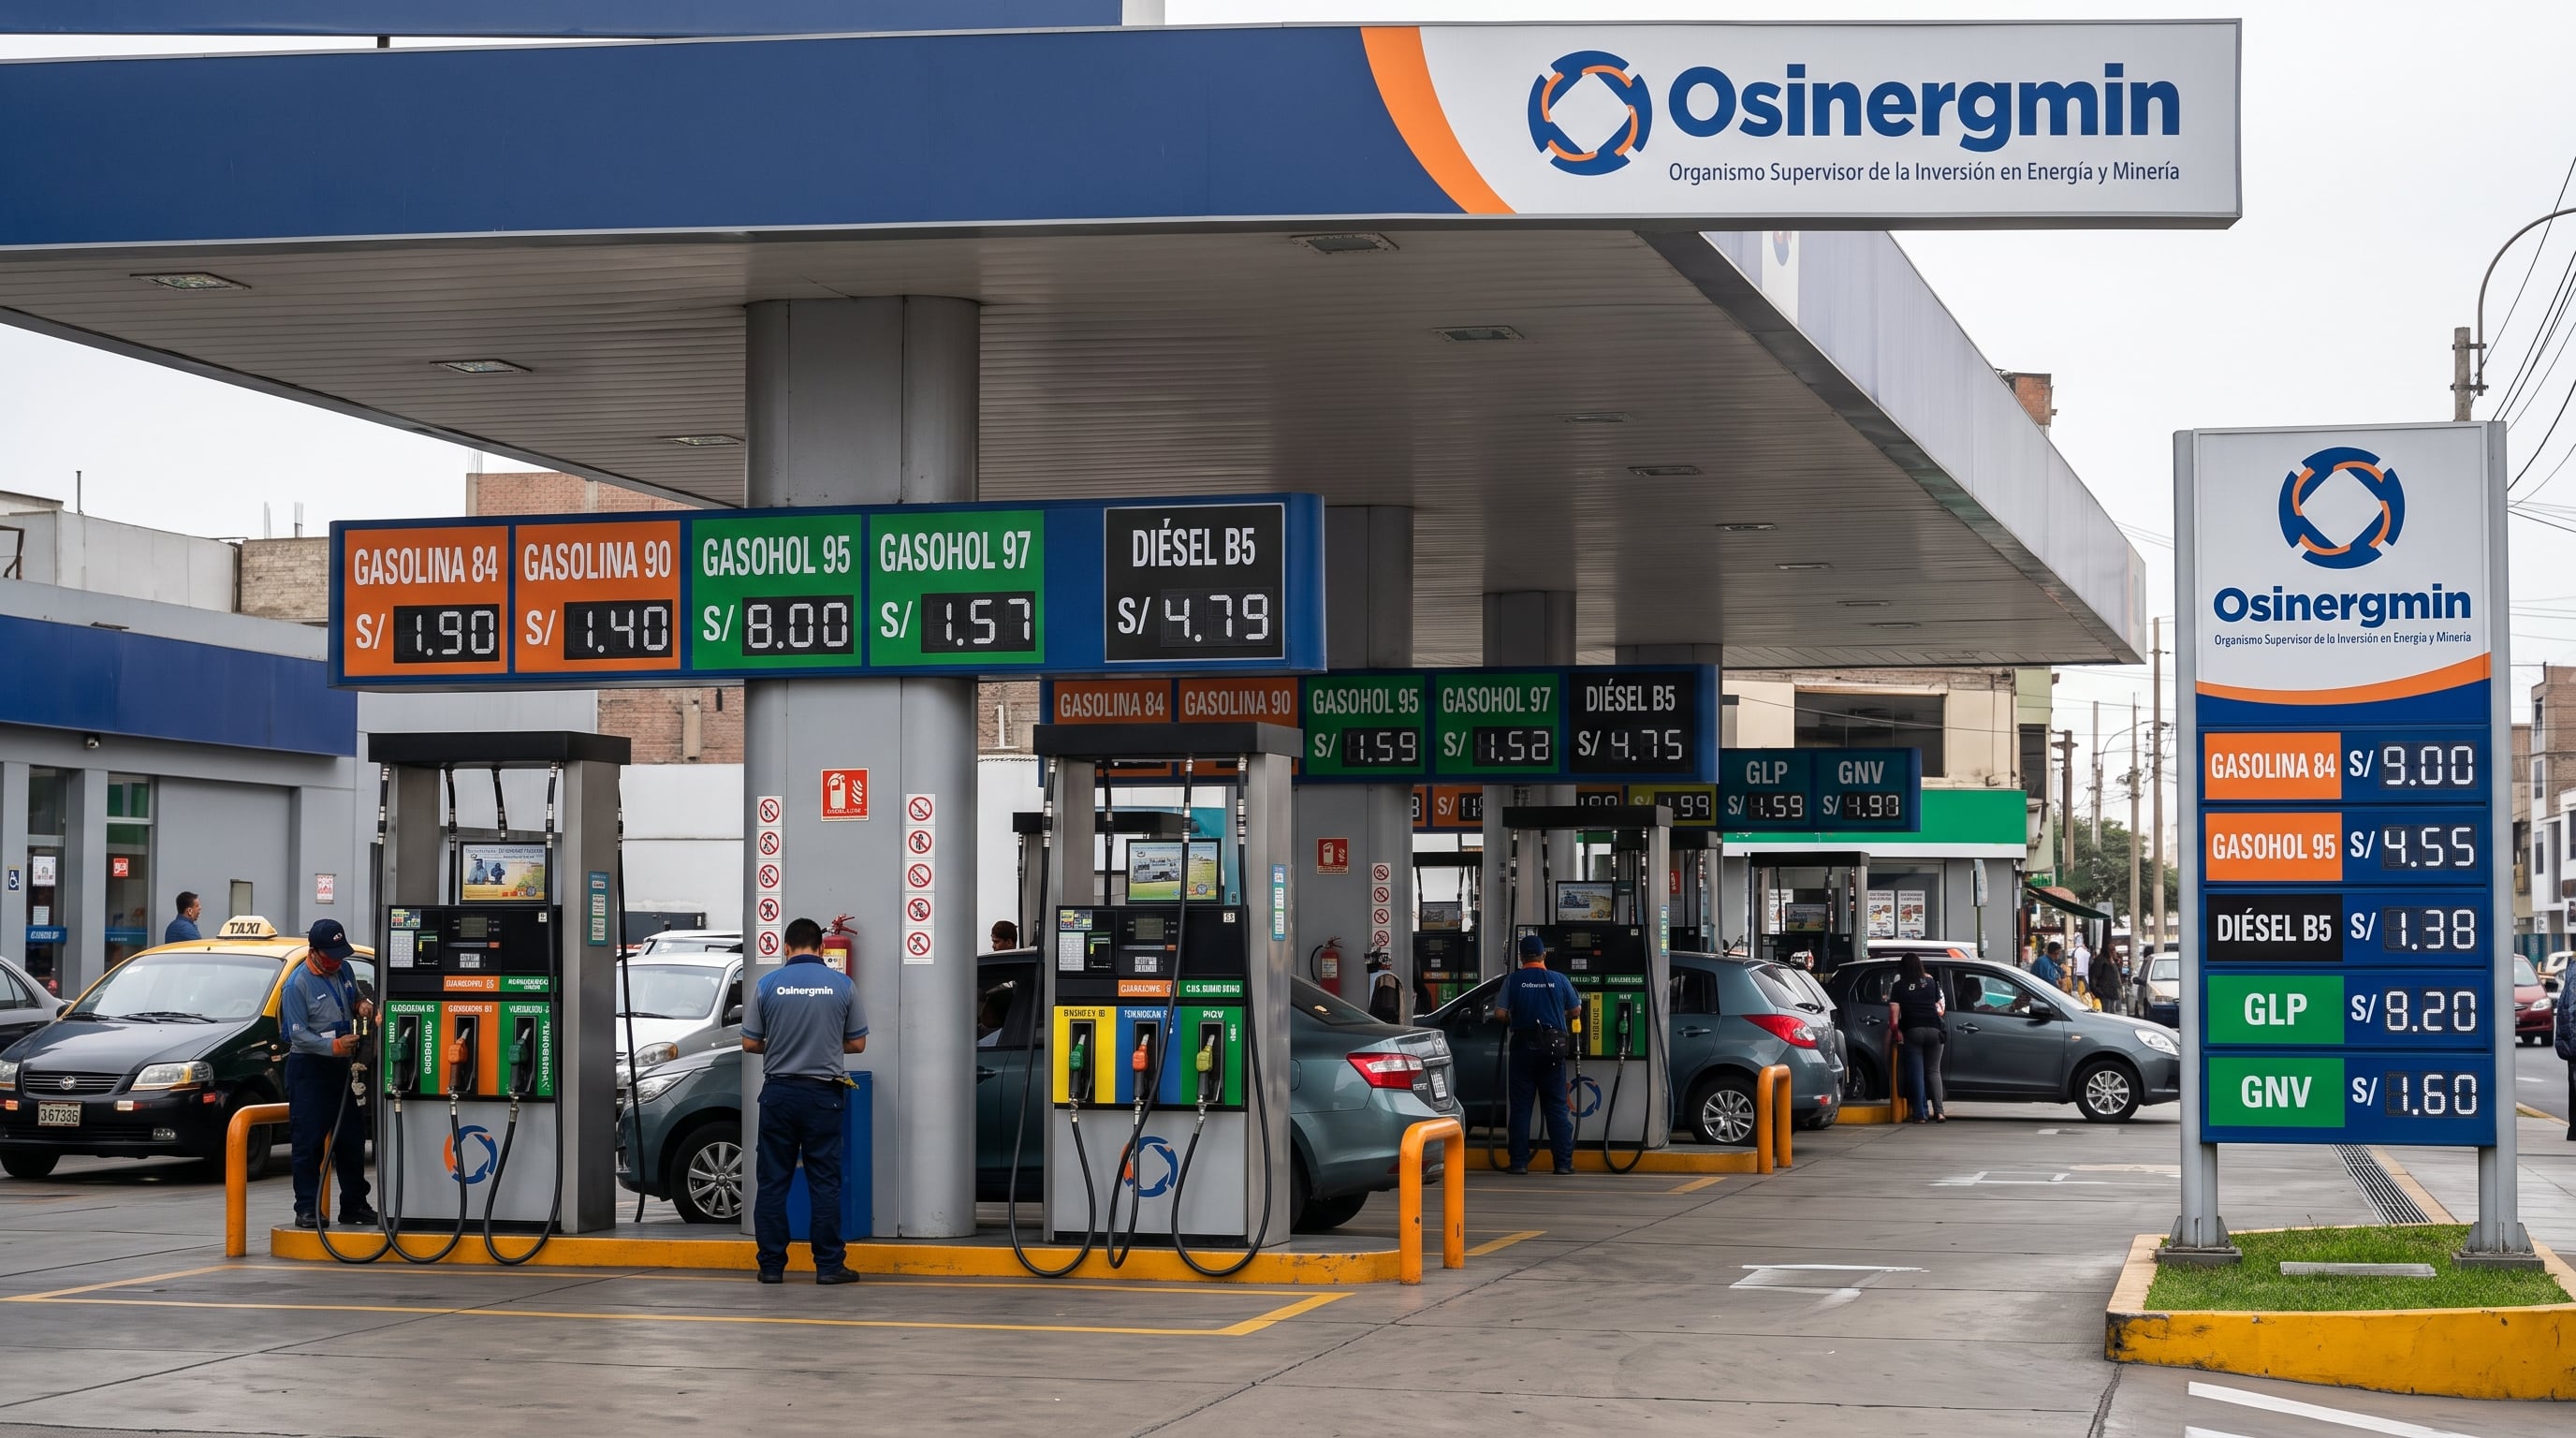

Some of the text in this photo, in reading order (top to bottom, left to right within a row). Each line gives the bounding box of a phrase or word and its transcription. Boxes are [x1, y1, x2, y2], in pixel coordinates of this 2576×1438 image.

[1668, 63, 2181, 153] Osinergmin
[1669, 161, 2179, 186] Organismo Supervisor de la Inversión en Energía y Minería
[702, 535, 851, 577] GASOHOL 95
[880, 530, 1032, 572] GASOHOL 97
[1133, 519, 1256, 567] DIÉSEL B5
[354, 545, 499, 586] GASOLINA 84
[523, 540, 671, 581] GASOLINA 90
[880, 597, 1031, 647] S/ 1.57
[1118, 594, 1268, 642] S/ 4.79
[2214, 583, 2472, 628] Osinergmin
[355, 610, 494, 655] S/ 1.90
[526, 606, 667, 653] S/ 1.40
[703, 602, 848, 649] S/ 8.00
[2215, 634, 2262, 648] Organismo
[2265, 634, 2312, 647] Supervisor
[2314, 634, 2325, 644] de
[2337, 633, 2378, 644] Inversión
[2428, 635, 2435, 645] y
[2437, 631, 2471, 642] Minería
[1060, 692, 1164, 718] GASOLINA 84
[1185, 690, 1291, 716] GASOLINA 90
[1312, 687, 1419, 714] GASOHOL 95
[1442, 685, 1551, 713] GASOHOL 97
[1586, 678, 1676, 712] DIÉSEL B5
[1314, 731, 1416, 764] S/ 1.59
[1443, 731, 1467, 757] S/
[1578, 729, 1682, 762] S/ 4.75
[1746, 760, 1788, 785] GLP
[1838, 760, 1884, 785] GNV
[2211, 753, 2335, 779] GASOLINA 84
[2349, 745, 2473, 786] S/ 9.00
[1438, 796, 1455, 815] S/
[1728, 795, 1745, 815] S/
[1822, 795, 1840, 815] S/
[2212, 833, 2336, 860] GASOHOL 95
[2349, 827, 2474, 868] S/ 4.55
[230, 922, 261, 934] TAXI
[2217, 907, 2332, 943] DIÉSEL B5
[2350, 909, 2475, 950] S/ 1.38
[777, 986, 833, 997] Osinergmin
[2244, 992, 2307, 1025] GLP
[2350, 990, 2476, 1033] S/ 8.20
[2241, 1076, 2312, 1108] GNV
[2351, 1074, 2477, 1115] S/ 1.60
